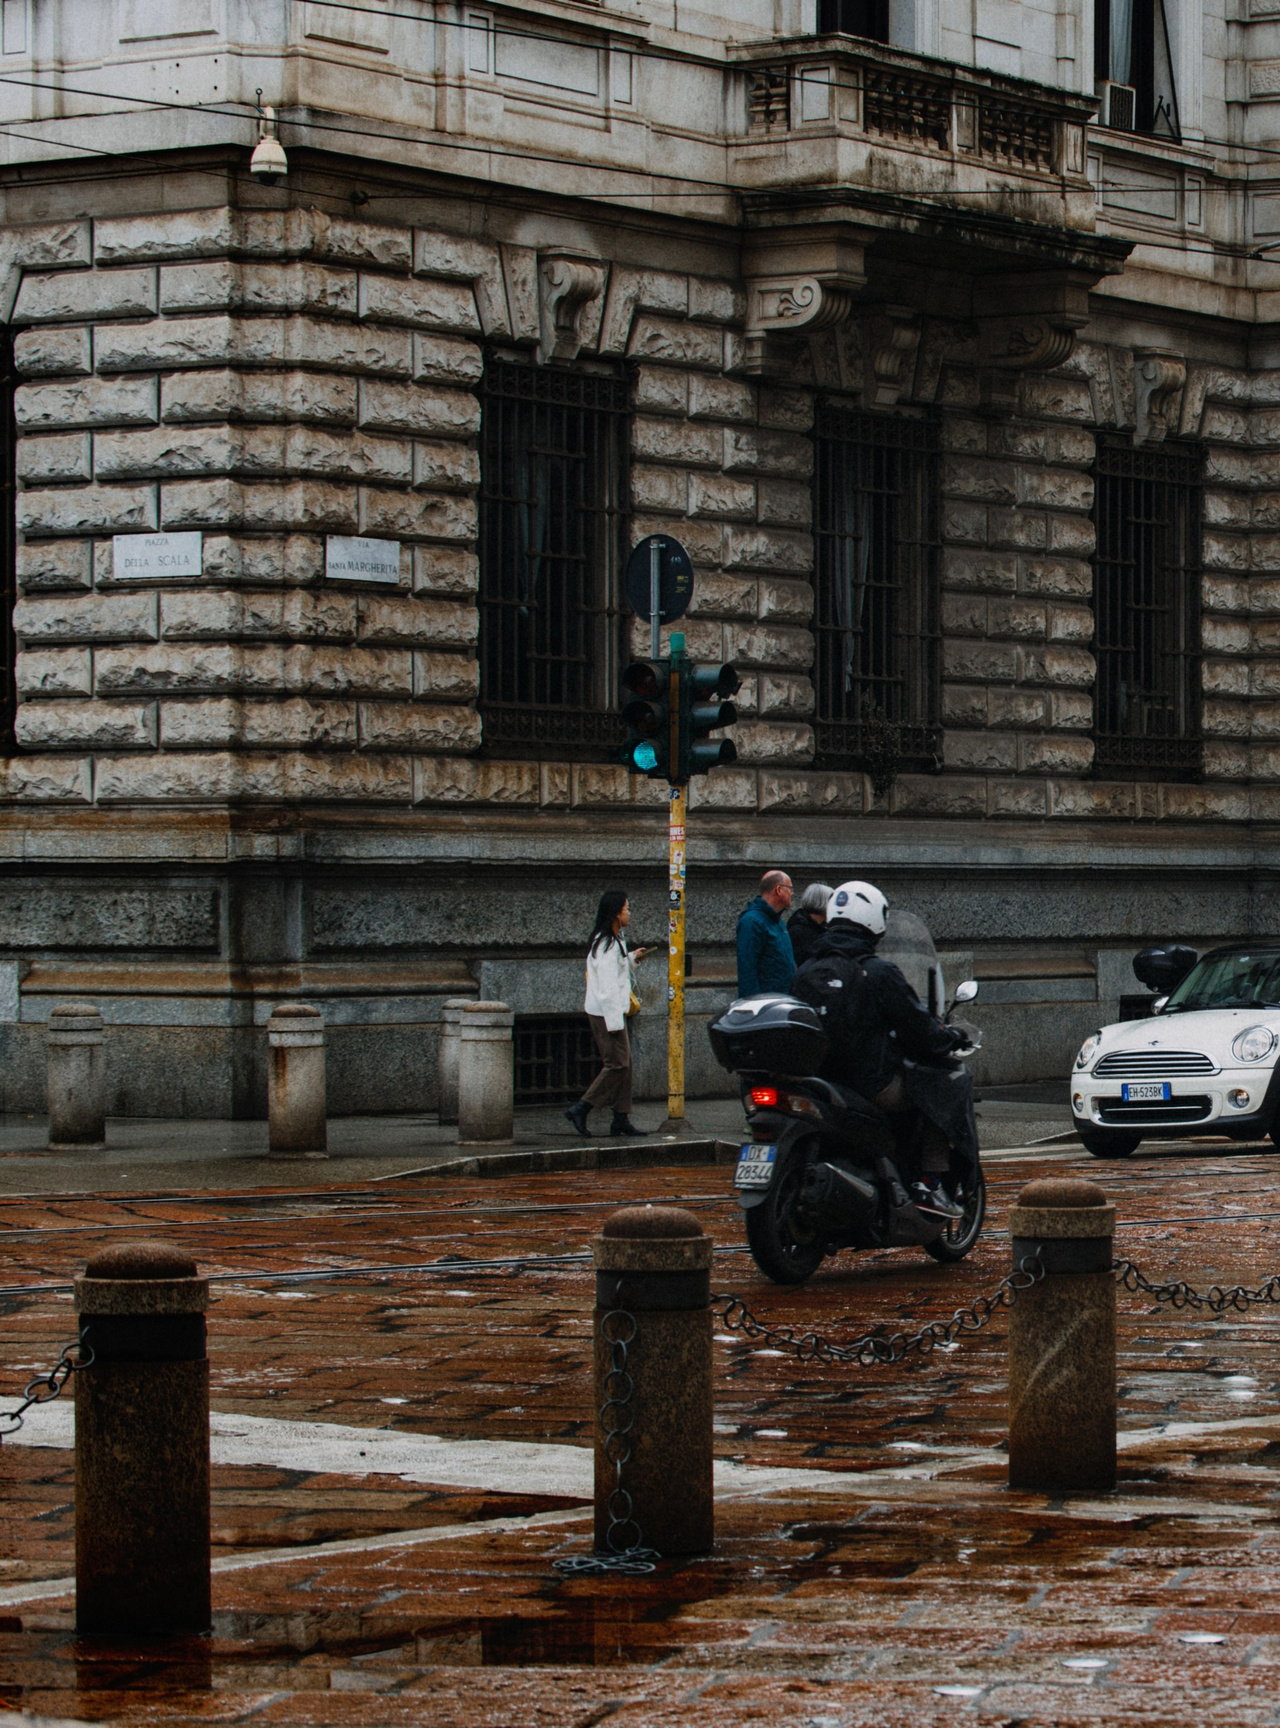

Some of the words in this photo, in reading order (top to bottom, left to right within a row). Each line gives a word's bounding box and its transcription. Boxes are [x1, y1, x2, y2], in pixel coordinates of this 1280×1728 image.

[145, 538, 169, 546] PIAZZA
[358, 540, 370, 548] VIA
[124, 558, 149, 568] DELLA
[158, 555, 190, 566] SCALA
[328, 561, 346, 570] SANTA
[347, 560, 398, 575] MARGHERITA
[737, 1165, 773, 1180] 28344
